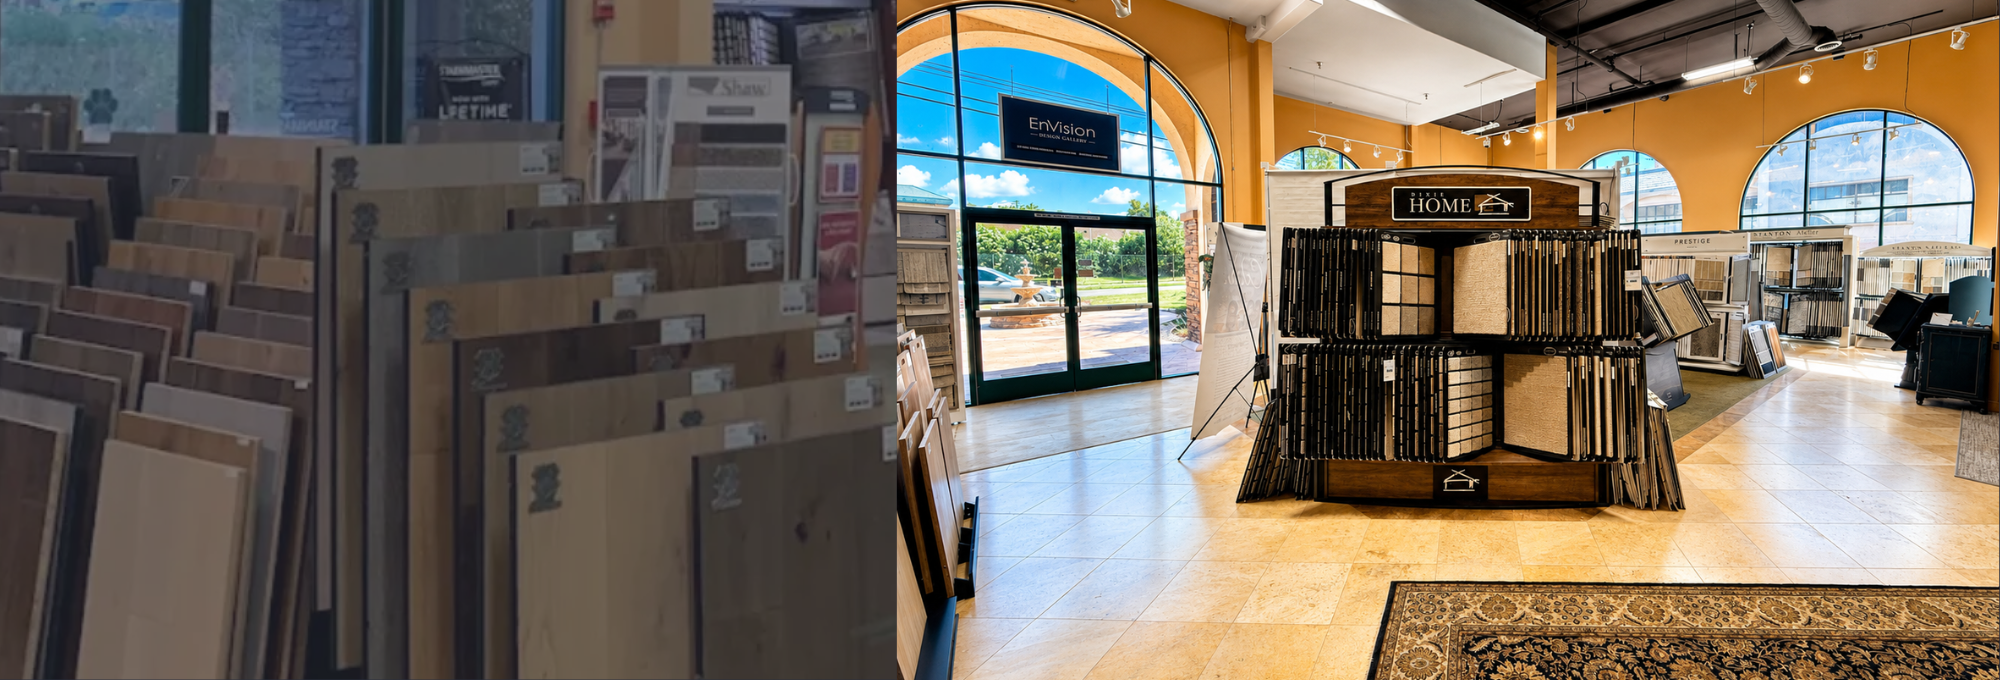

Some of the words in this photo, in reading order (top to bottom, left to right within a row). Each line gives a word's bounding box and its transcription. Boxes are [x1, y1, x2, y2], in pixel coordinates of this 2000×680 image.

[722, 79, 767, 96] Shaw
[438, 103, 509, 120] LFETIME
[1029, 117, 1096, 138] EnVision
[1038, 132, 1061, 140] DESIGN
[1061, 136, 1088, 144] GALLERY
[1409, 198, 1472, 214] HOME
